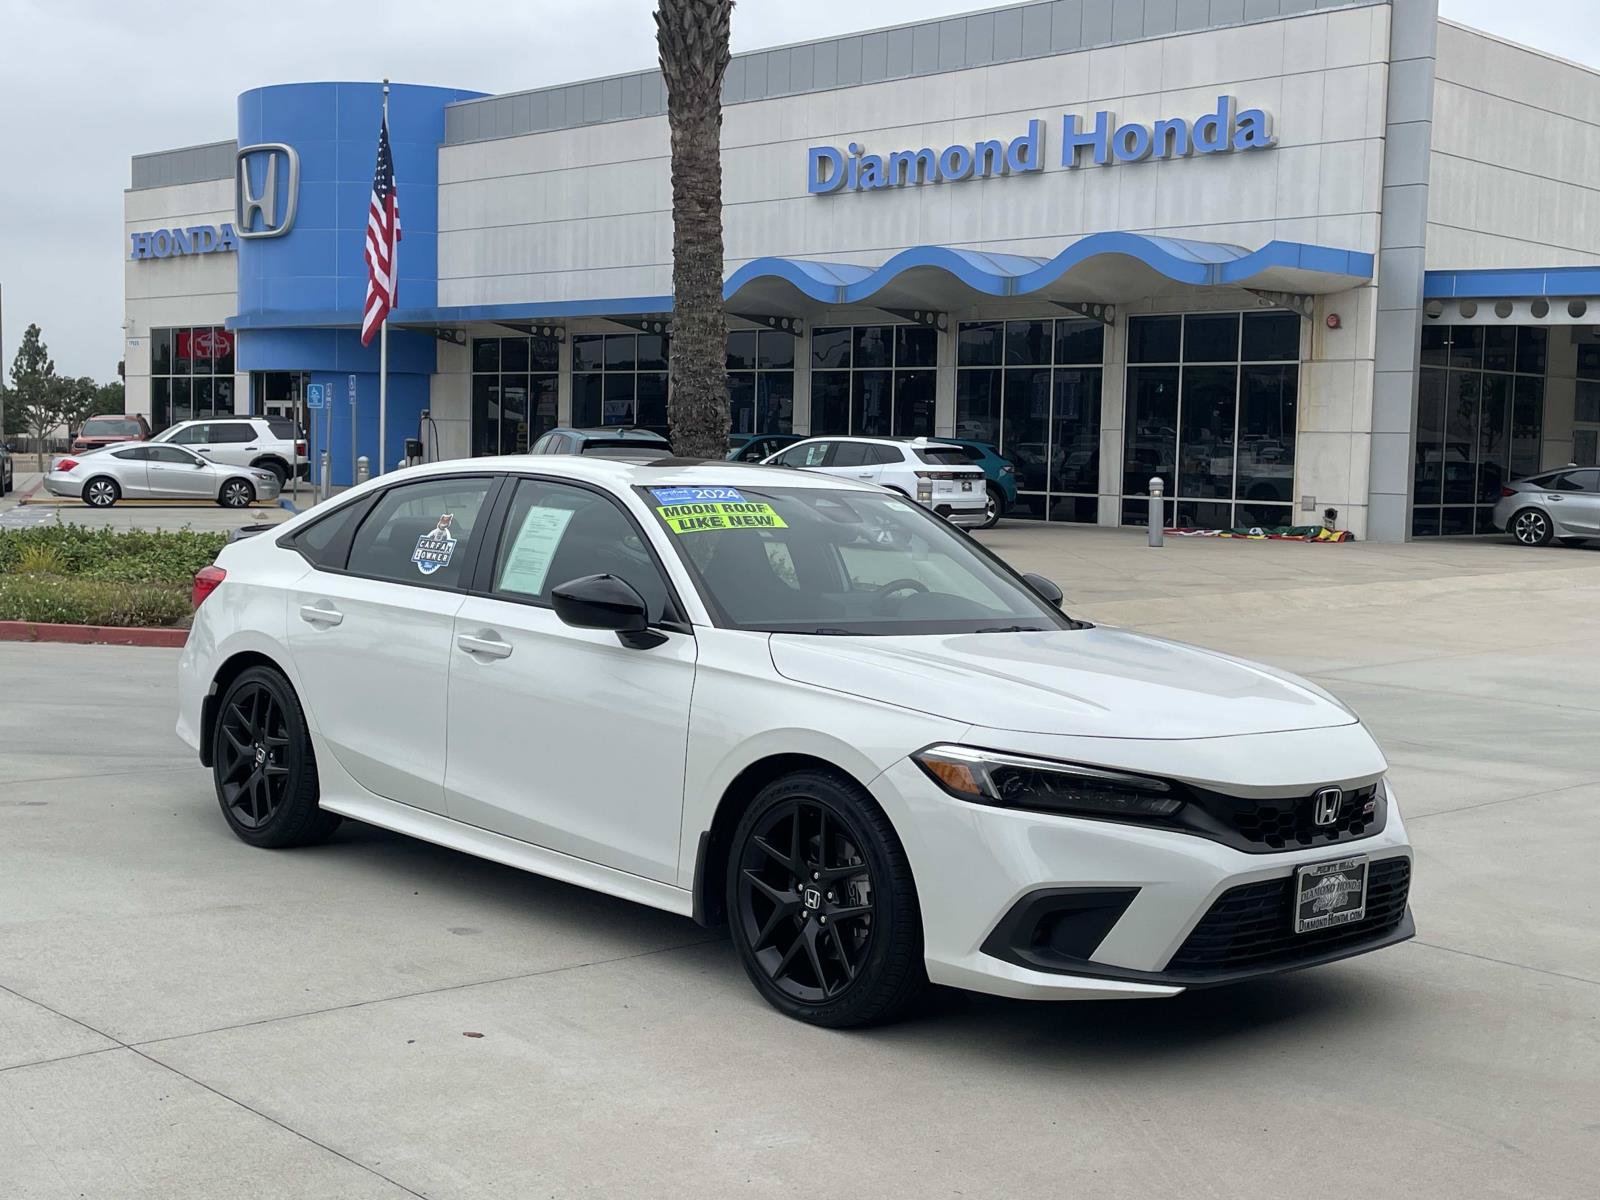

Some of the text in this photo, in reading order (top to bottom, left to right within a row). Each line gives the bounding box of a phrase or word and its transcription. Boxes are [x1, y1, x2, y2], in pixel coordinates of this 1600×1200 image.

[808, 94, 1277, 195] Diamond Honda
[131, 223, 239, 260] HONDA
[693, 489, 740, 500] 2024
[662, 502, 768, 518] MOON ROOF
[678, 515, 775, 530] LIKE NEW
[420, 550, 448, 562] OWNER
